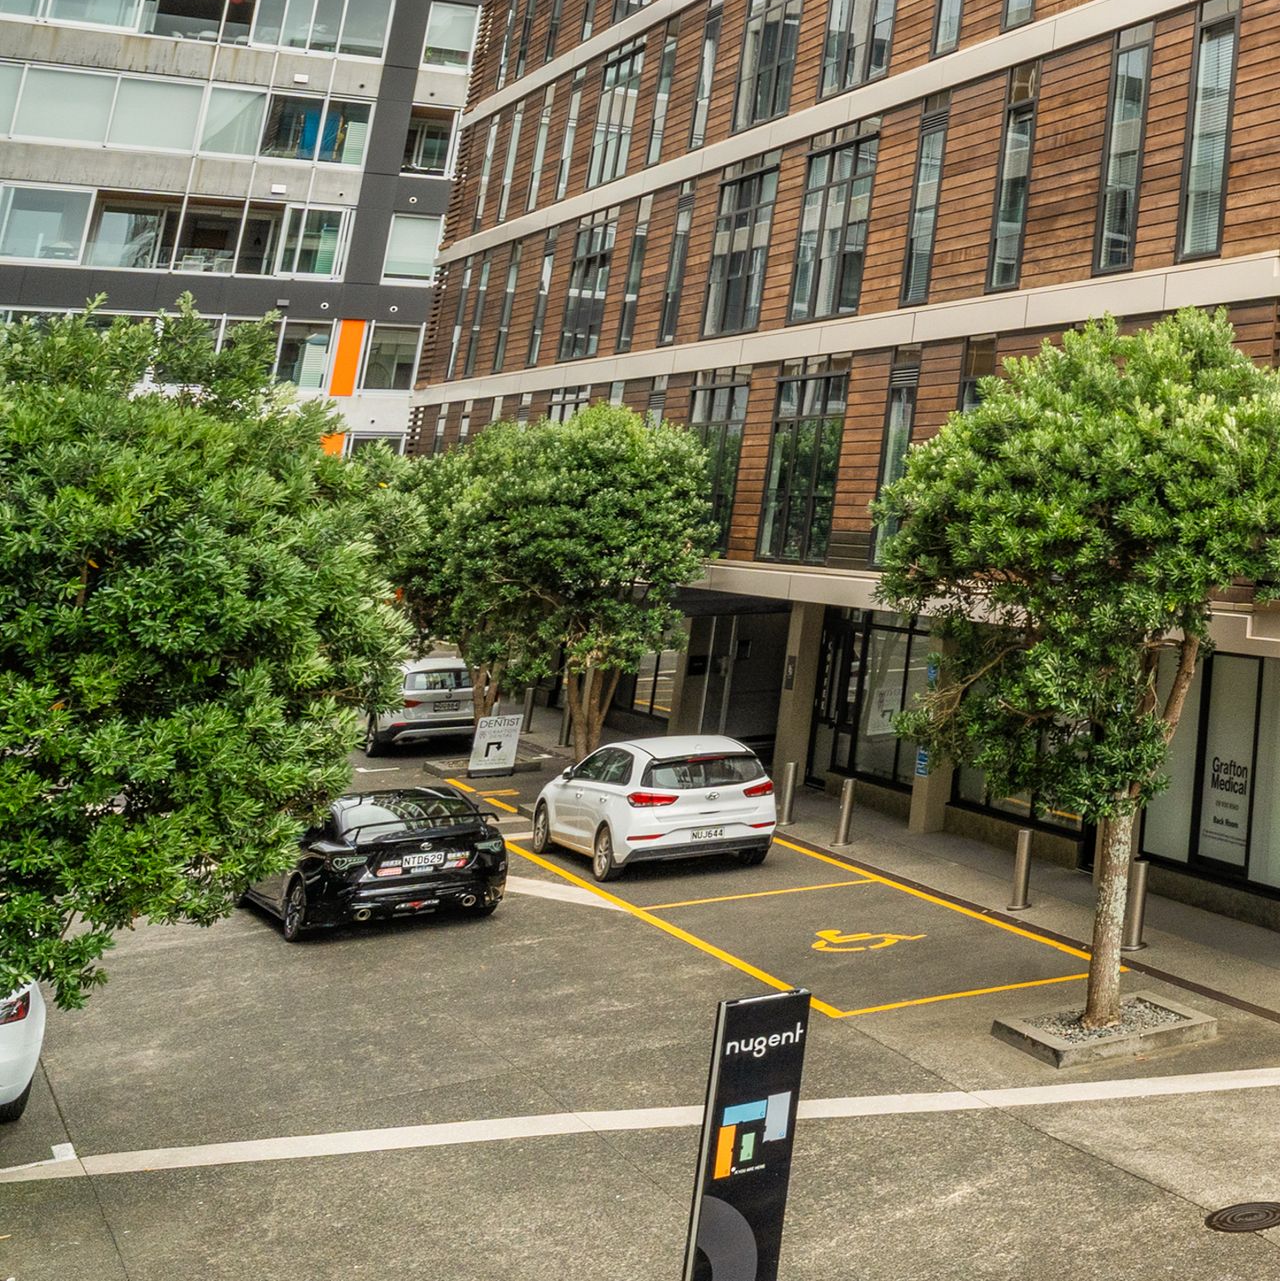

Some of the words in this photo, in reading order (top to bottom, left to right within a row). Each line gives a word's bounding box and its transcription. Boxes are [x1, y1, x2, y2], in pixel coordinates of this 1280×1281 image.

[480, 718, 520, 728] DENTIST
[1212, 756, 1248, 778] Grafton
[1211, 773, 1247, 795] Medical
[692, 829, 723, 839] NUJ644
[404, 853, 443, 866] NTD629
[725, 1022, 804, 1058] nugent
